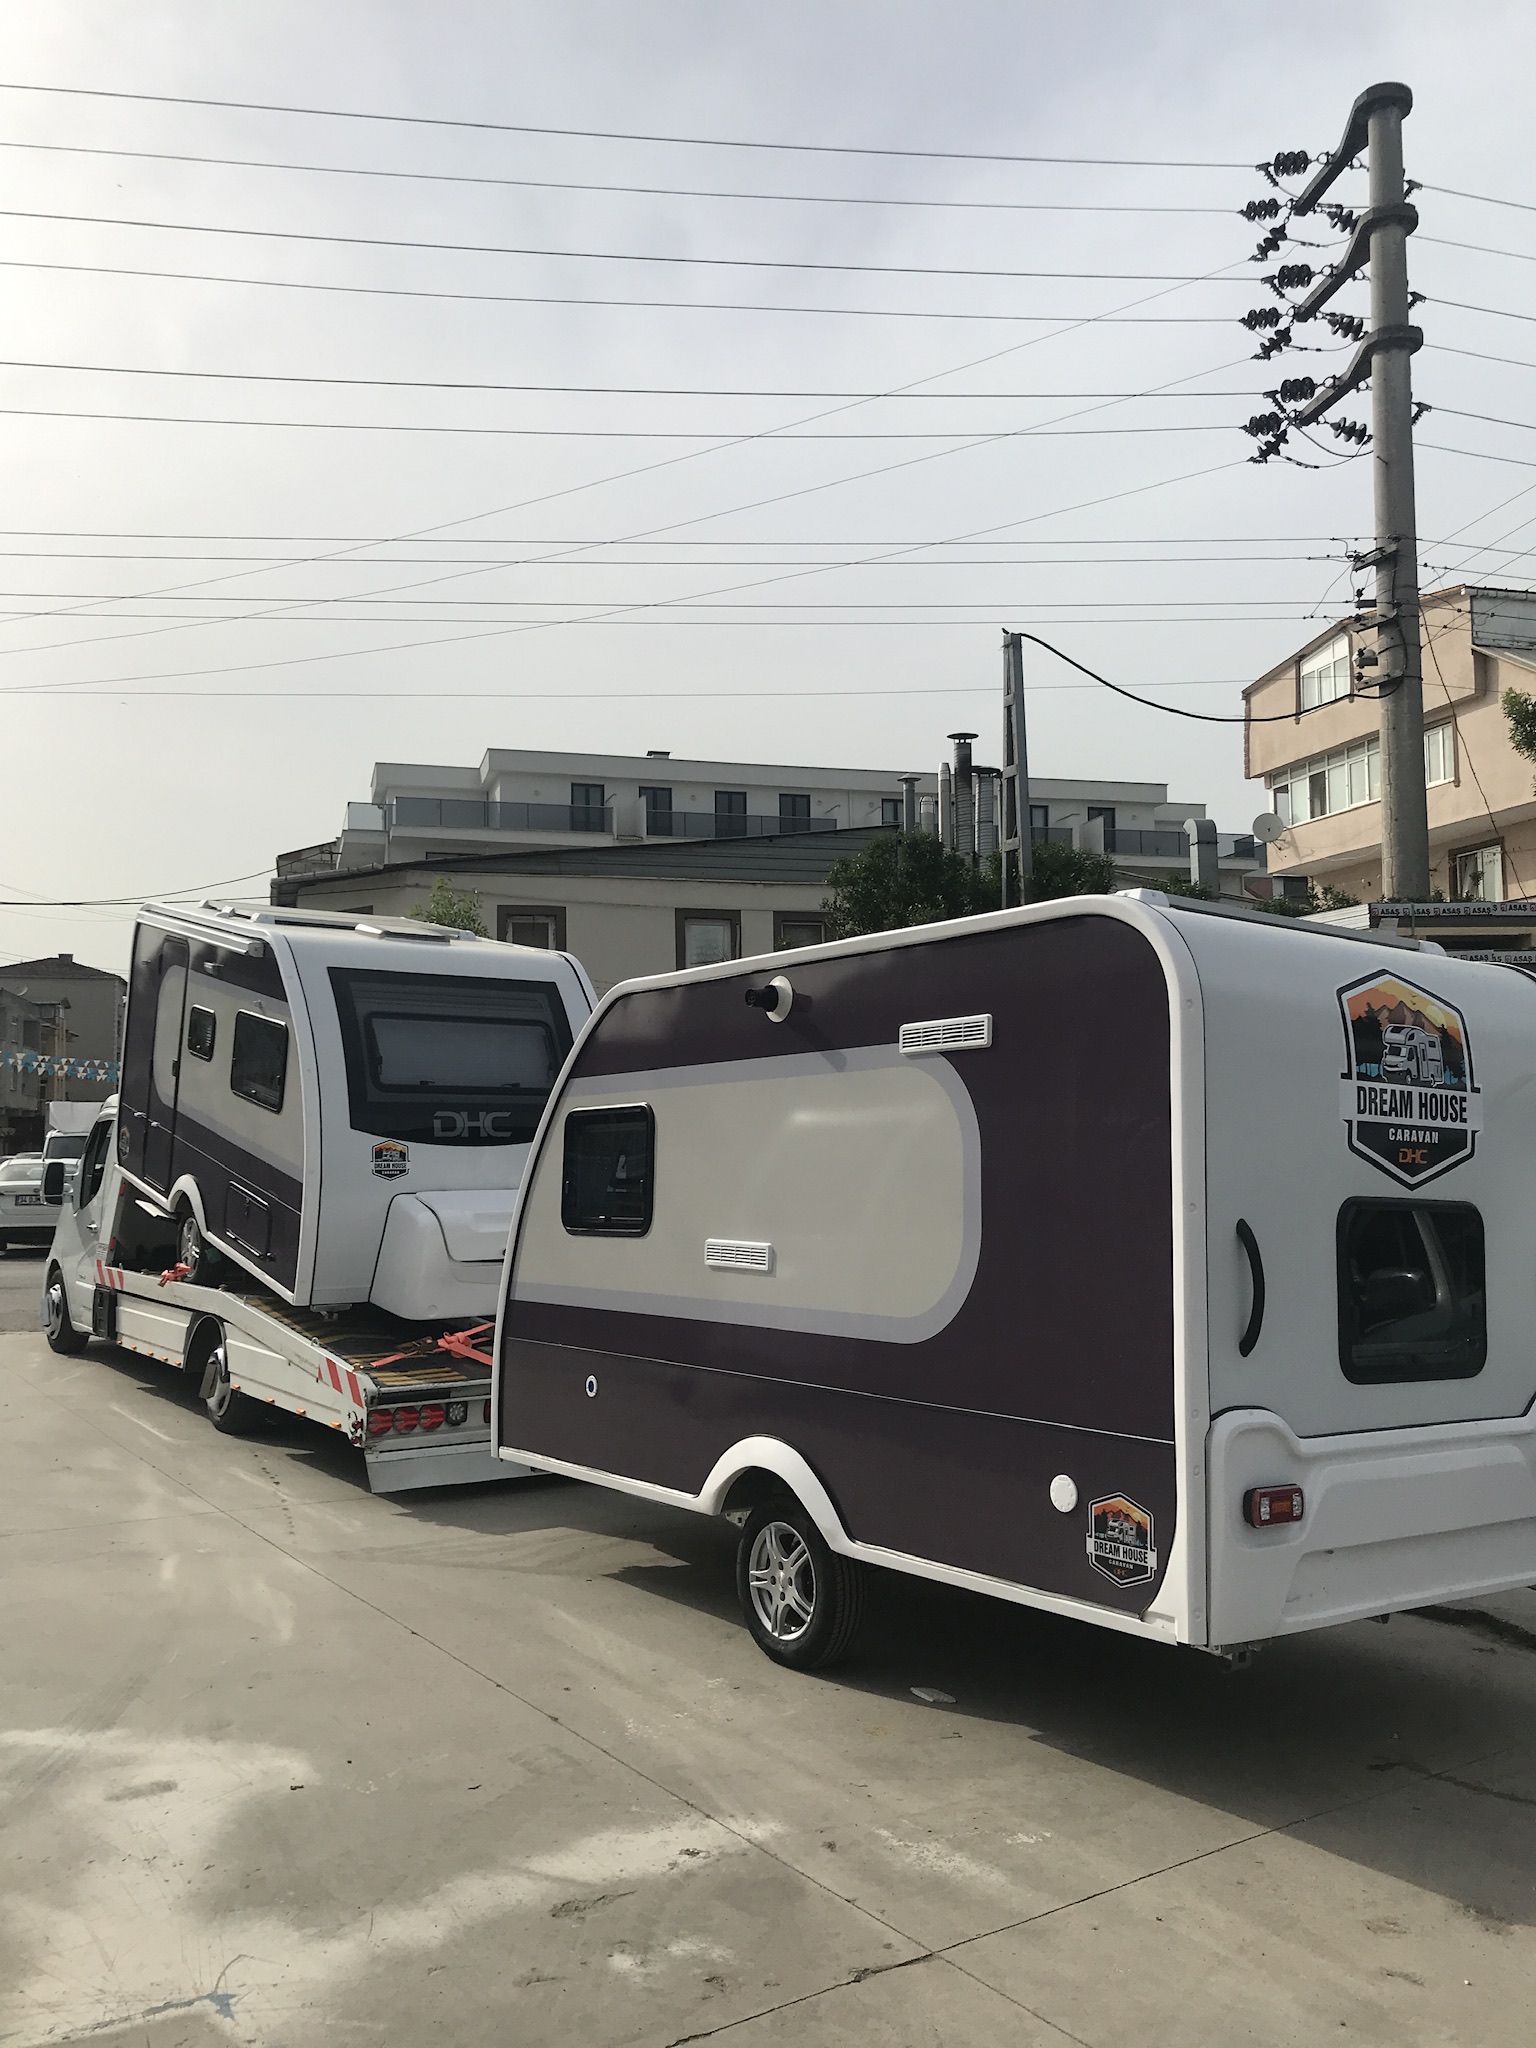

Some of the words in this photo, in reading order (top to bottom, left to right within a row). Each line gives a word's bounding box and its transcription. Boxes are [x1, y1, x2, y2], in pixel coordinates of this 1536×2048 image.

[1356, 1085, 1413, 1119] DREAM
[1418, 1089, 1468, 1124] HOUSE
[433, 1111, 513, 1138] DHC
[1388, 1127, 1439, 1144] CARAVAN
[1399, 1148, 1428, 1165] DHC
[1093, 1540, 1120, 1558] DREAM
[1122, 1545, 1148, 1565] HOUSE
